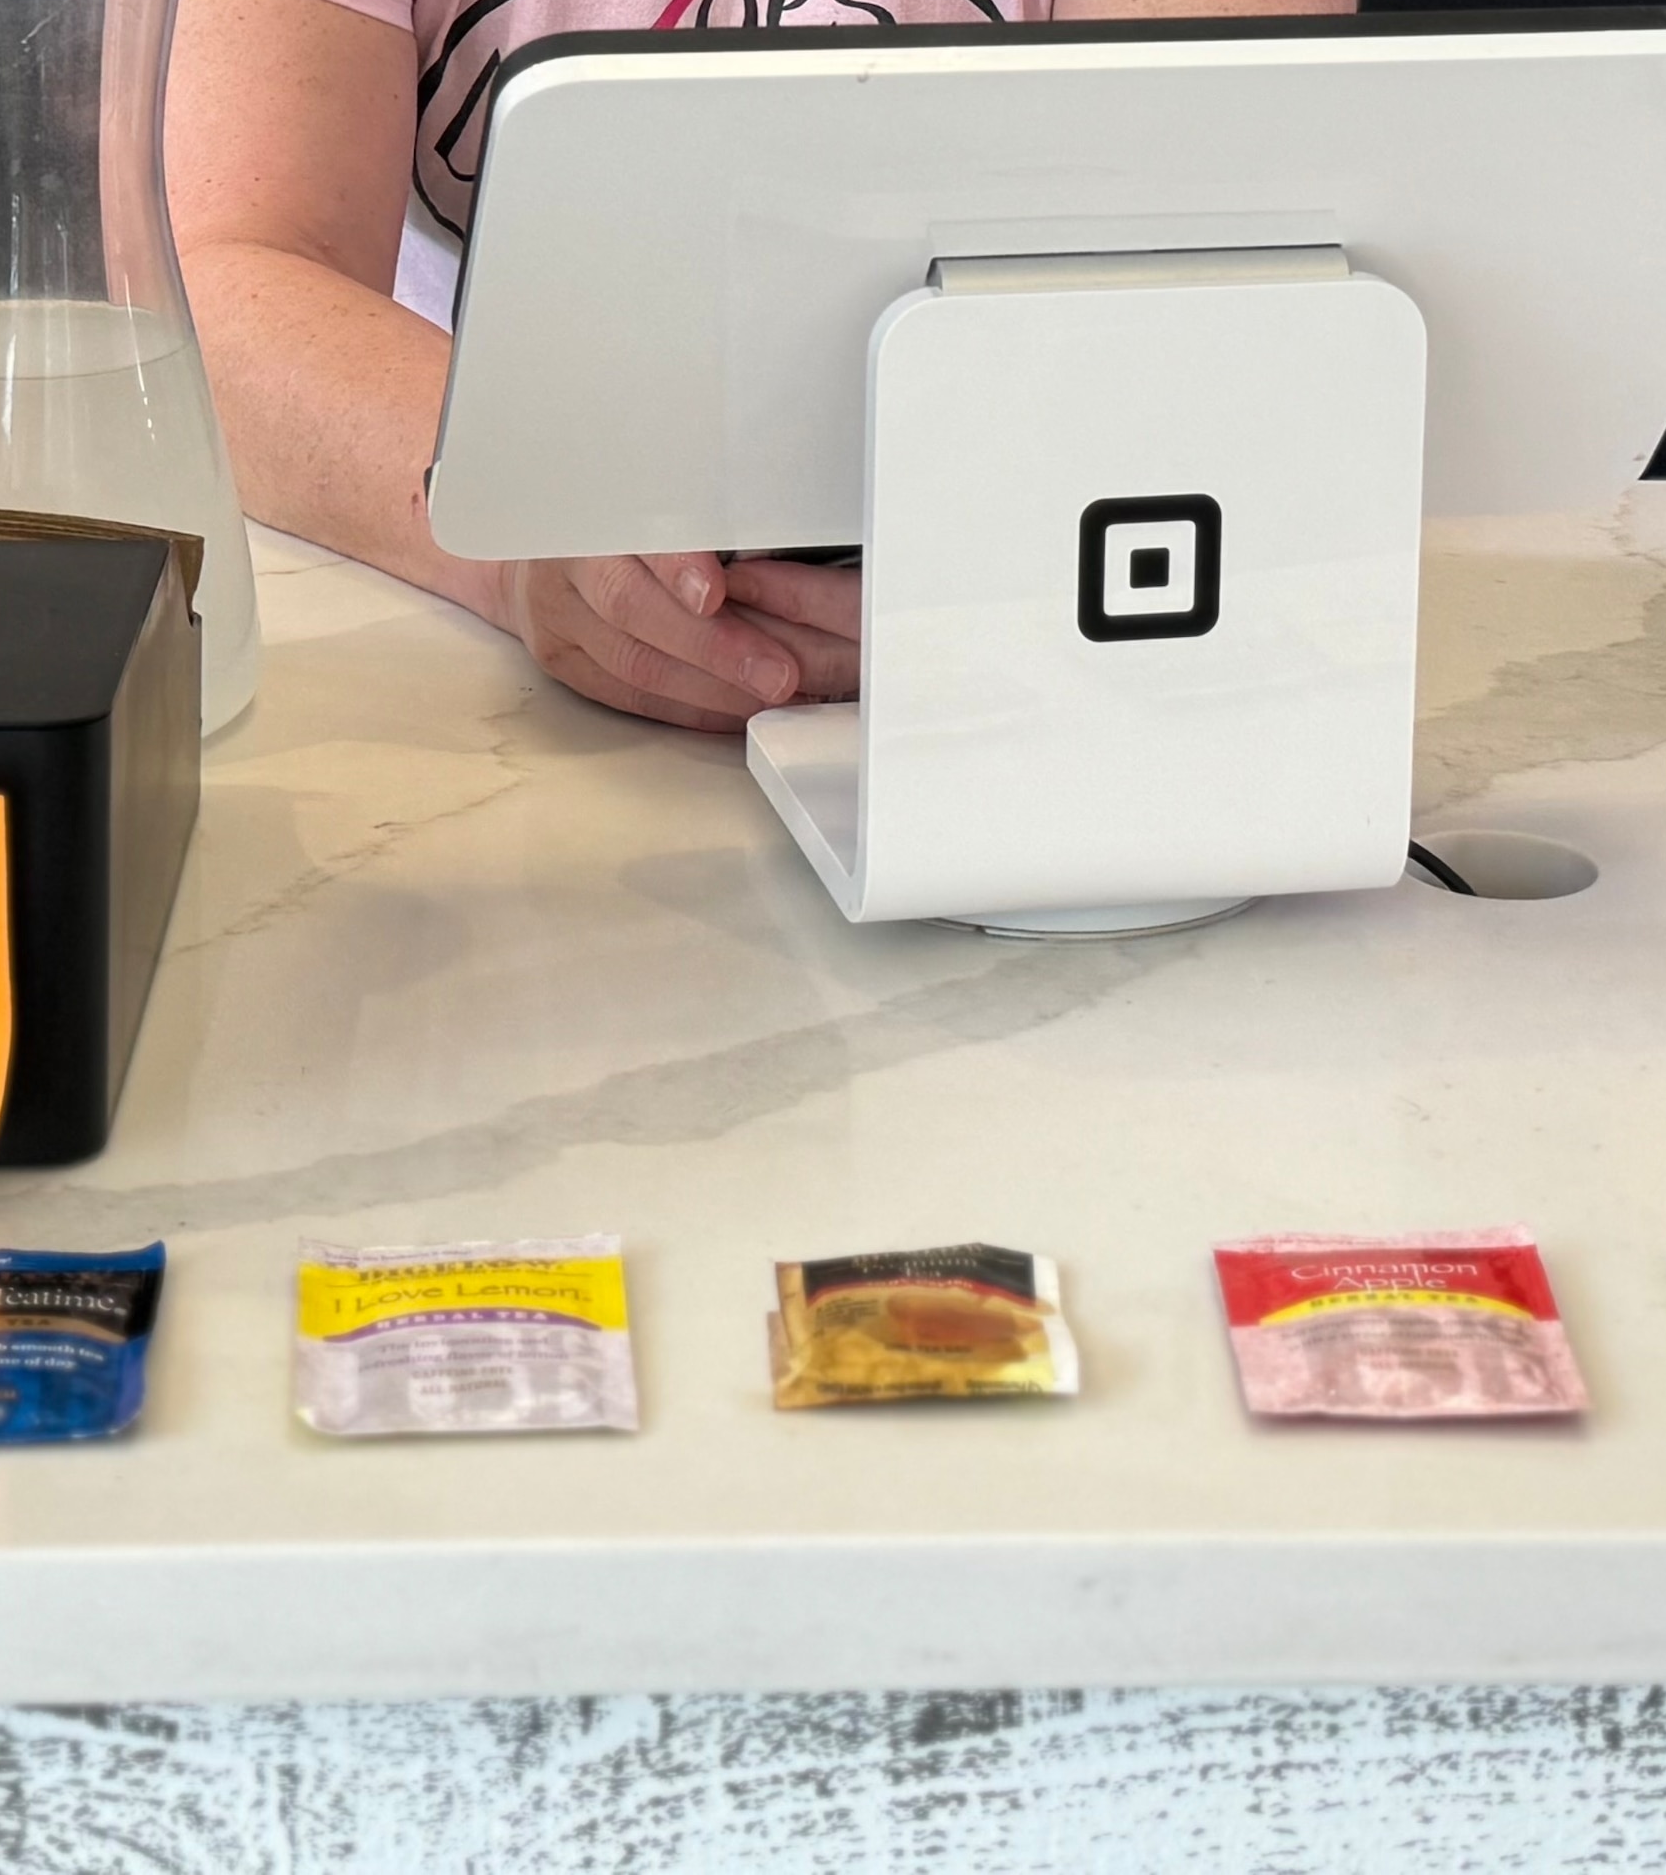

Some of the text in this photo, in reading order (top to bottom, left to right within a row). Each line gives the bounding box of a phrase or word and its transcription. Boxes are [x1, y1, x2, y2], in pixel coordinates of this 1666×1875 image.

[1290, 1262, 1479, 1281] Cinnamon
[1333, 1275, 1448, 1293] Apple
[355, 1284, 445, 1313] Love
[455, 1282, 582, 1302] Lemon
[376, 1310, 549, 1331] HERBAL TEA
